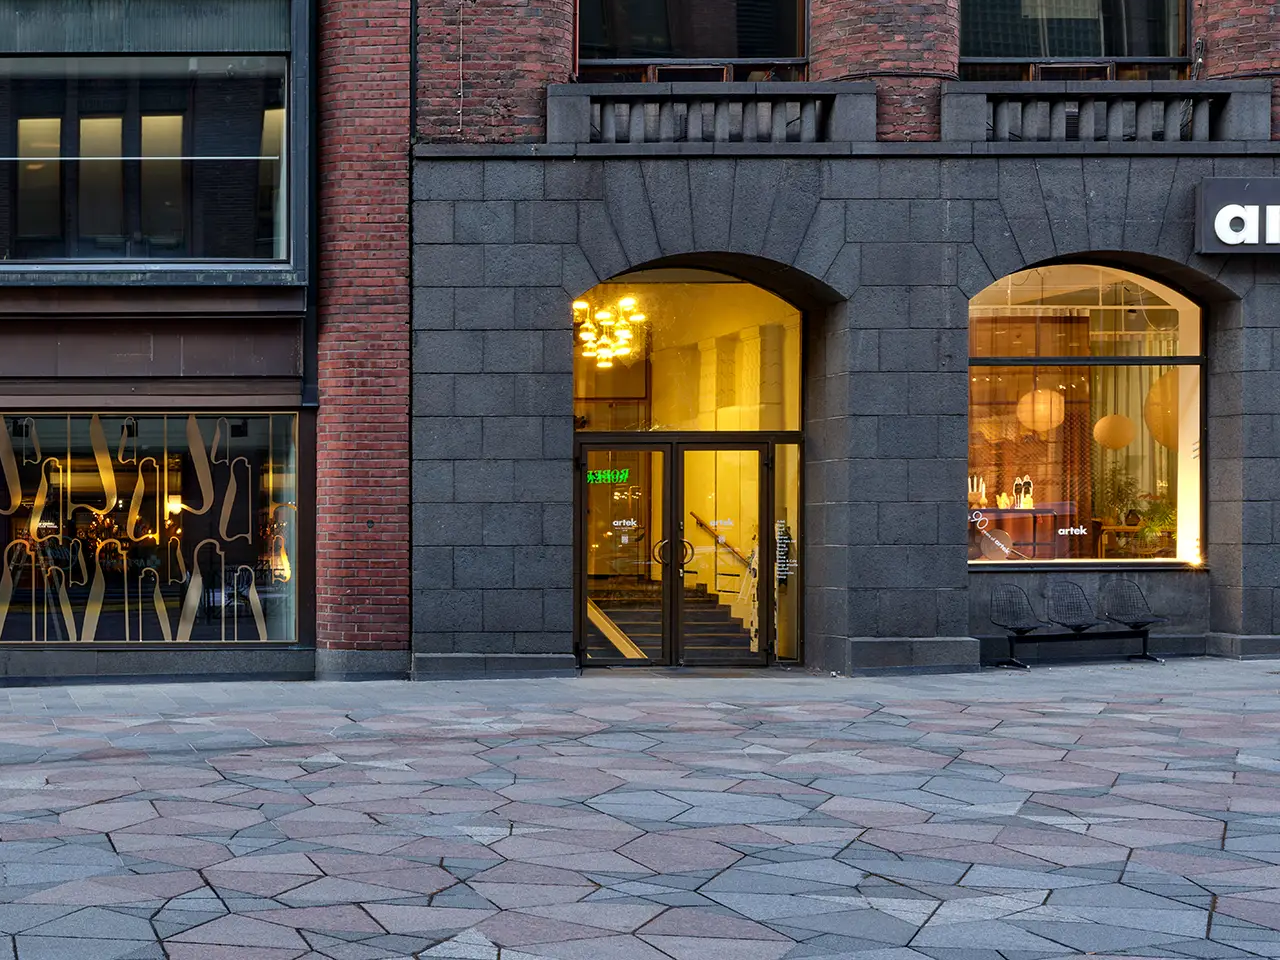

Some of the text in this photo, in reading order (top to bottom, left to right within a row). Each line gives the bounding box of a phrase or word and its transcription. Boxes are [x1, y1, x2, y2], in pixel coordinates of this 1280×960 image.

[612, 517, 638, 527] artek
[970, 510, 989, 530] 90
[1057, 524, 1088, 536] artek
